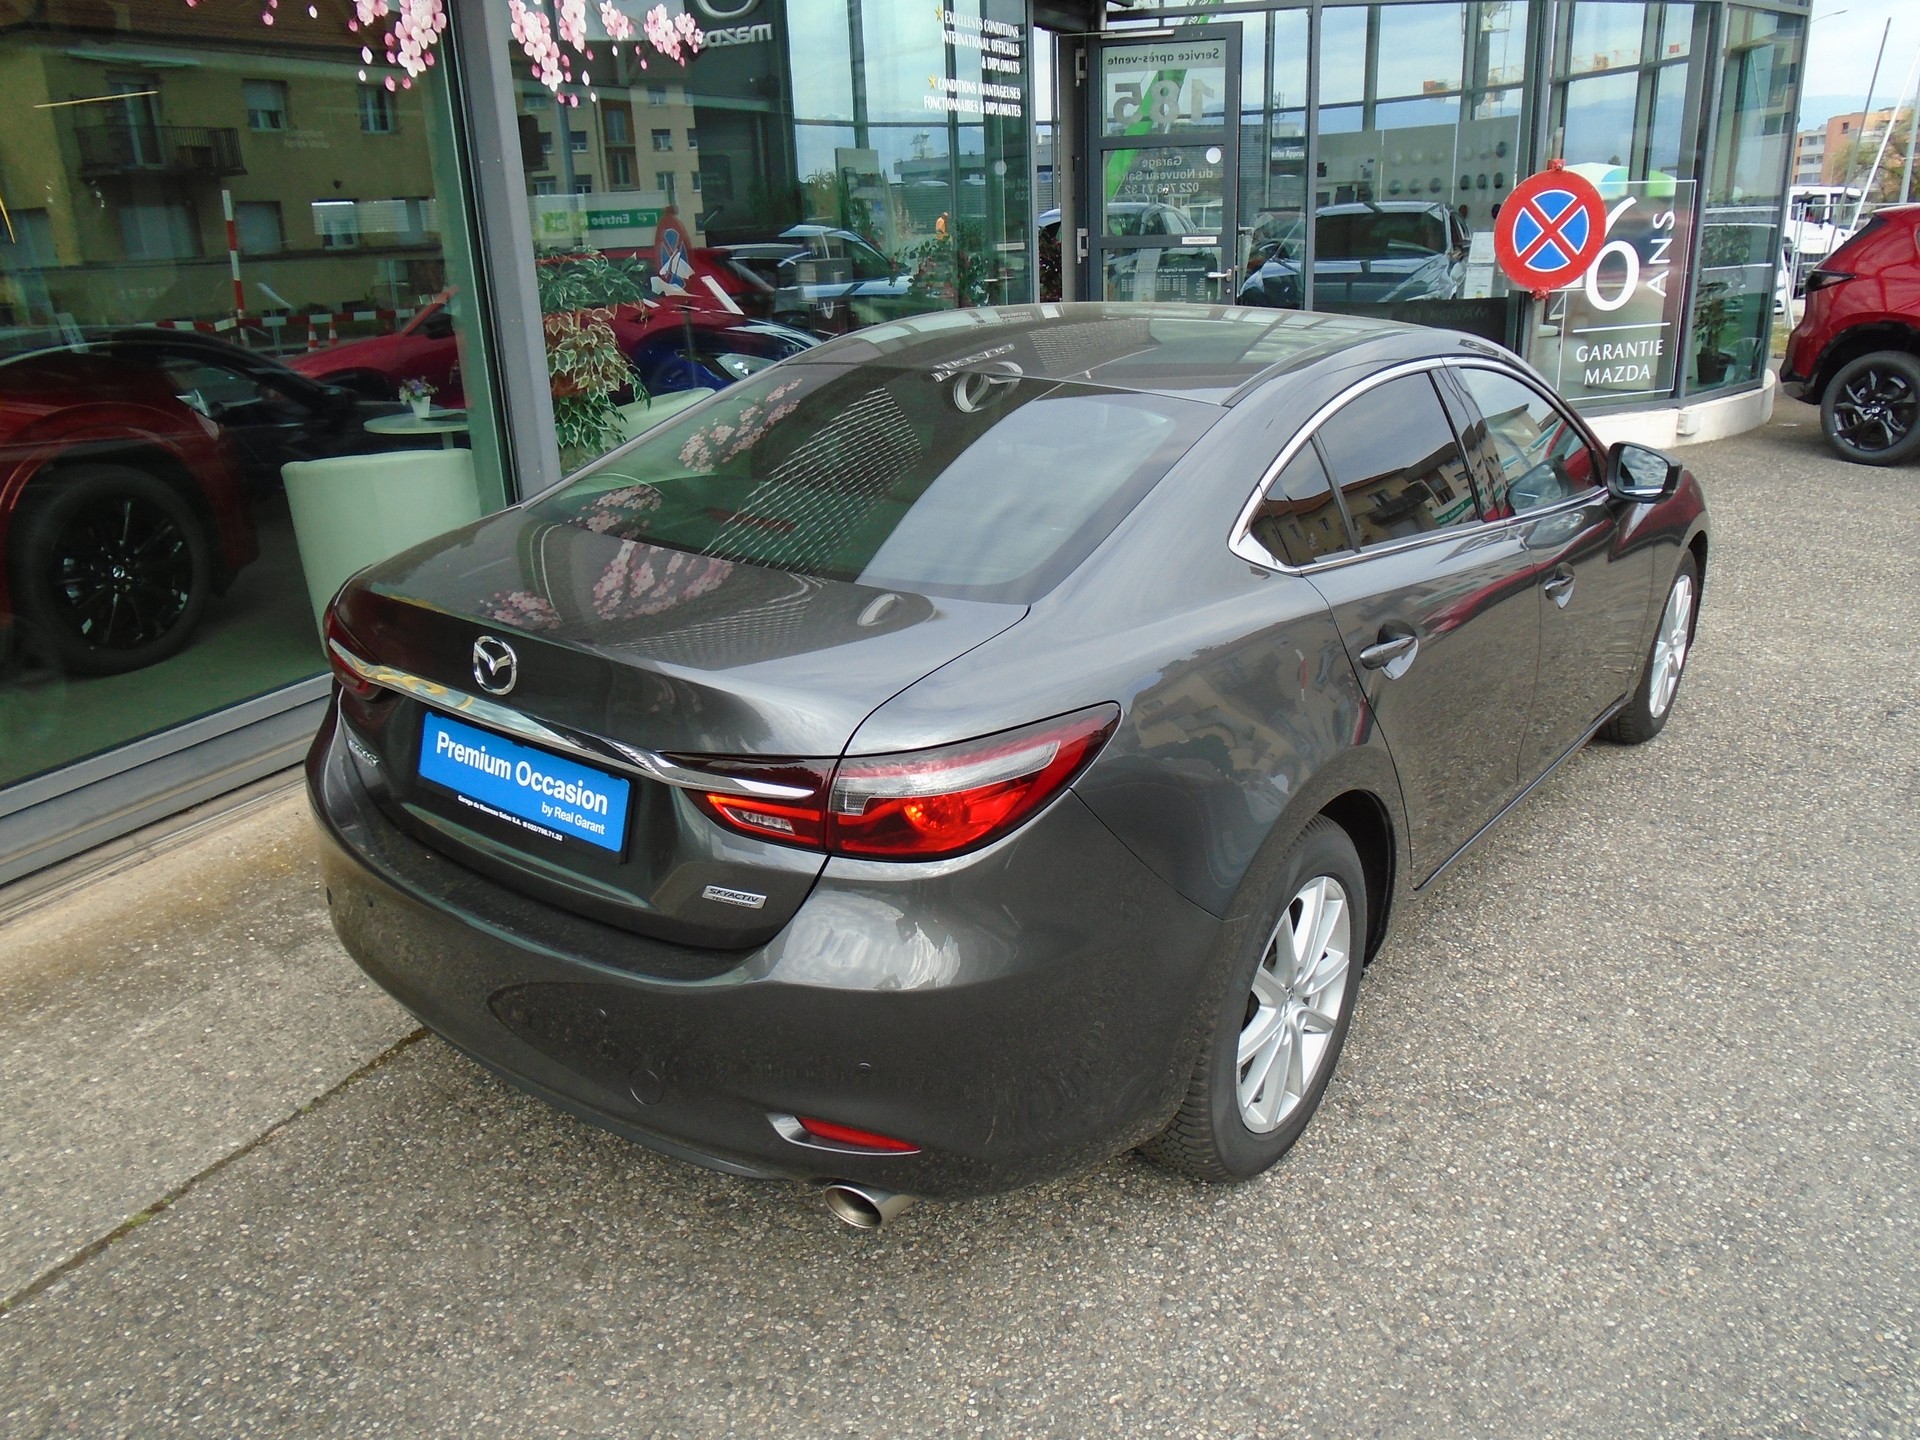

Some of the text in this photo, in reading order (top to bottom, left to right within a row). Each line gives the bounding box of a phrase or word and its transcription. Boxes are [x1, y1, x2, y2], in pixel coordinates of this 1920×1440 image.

[944, 10, 1019, 38] EXCELLENTS CONDITIONS
[941, 29, 1020, 57] INTERNATIONAL OFFICIALS
[981, 55, 1020, 74] & DIPLOMATS
[937, 77, 1021, 100] CONDITIONS AVANTAGEUSES
[923, 95, 979, 113] FONCTIONNAIRES
[985, 101, 1021, 118] DIPLOMATES
[1585, 196, 1675, 311] 6 ANS
[1576, 339, 1664, 362] GARANTIE
[1584, 364, 1651, 386] MAZDA
[436, 731, 511, 780] Premium
[515, 760, 608, 815] Occasion
[541, 802, 606, 835] by Real Garant
[708, 888, 759, 902] SKYACTIV
